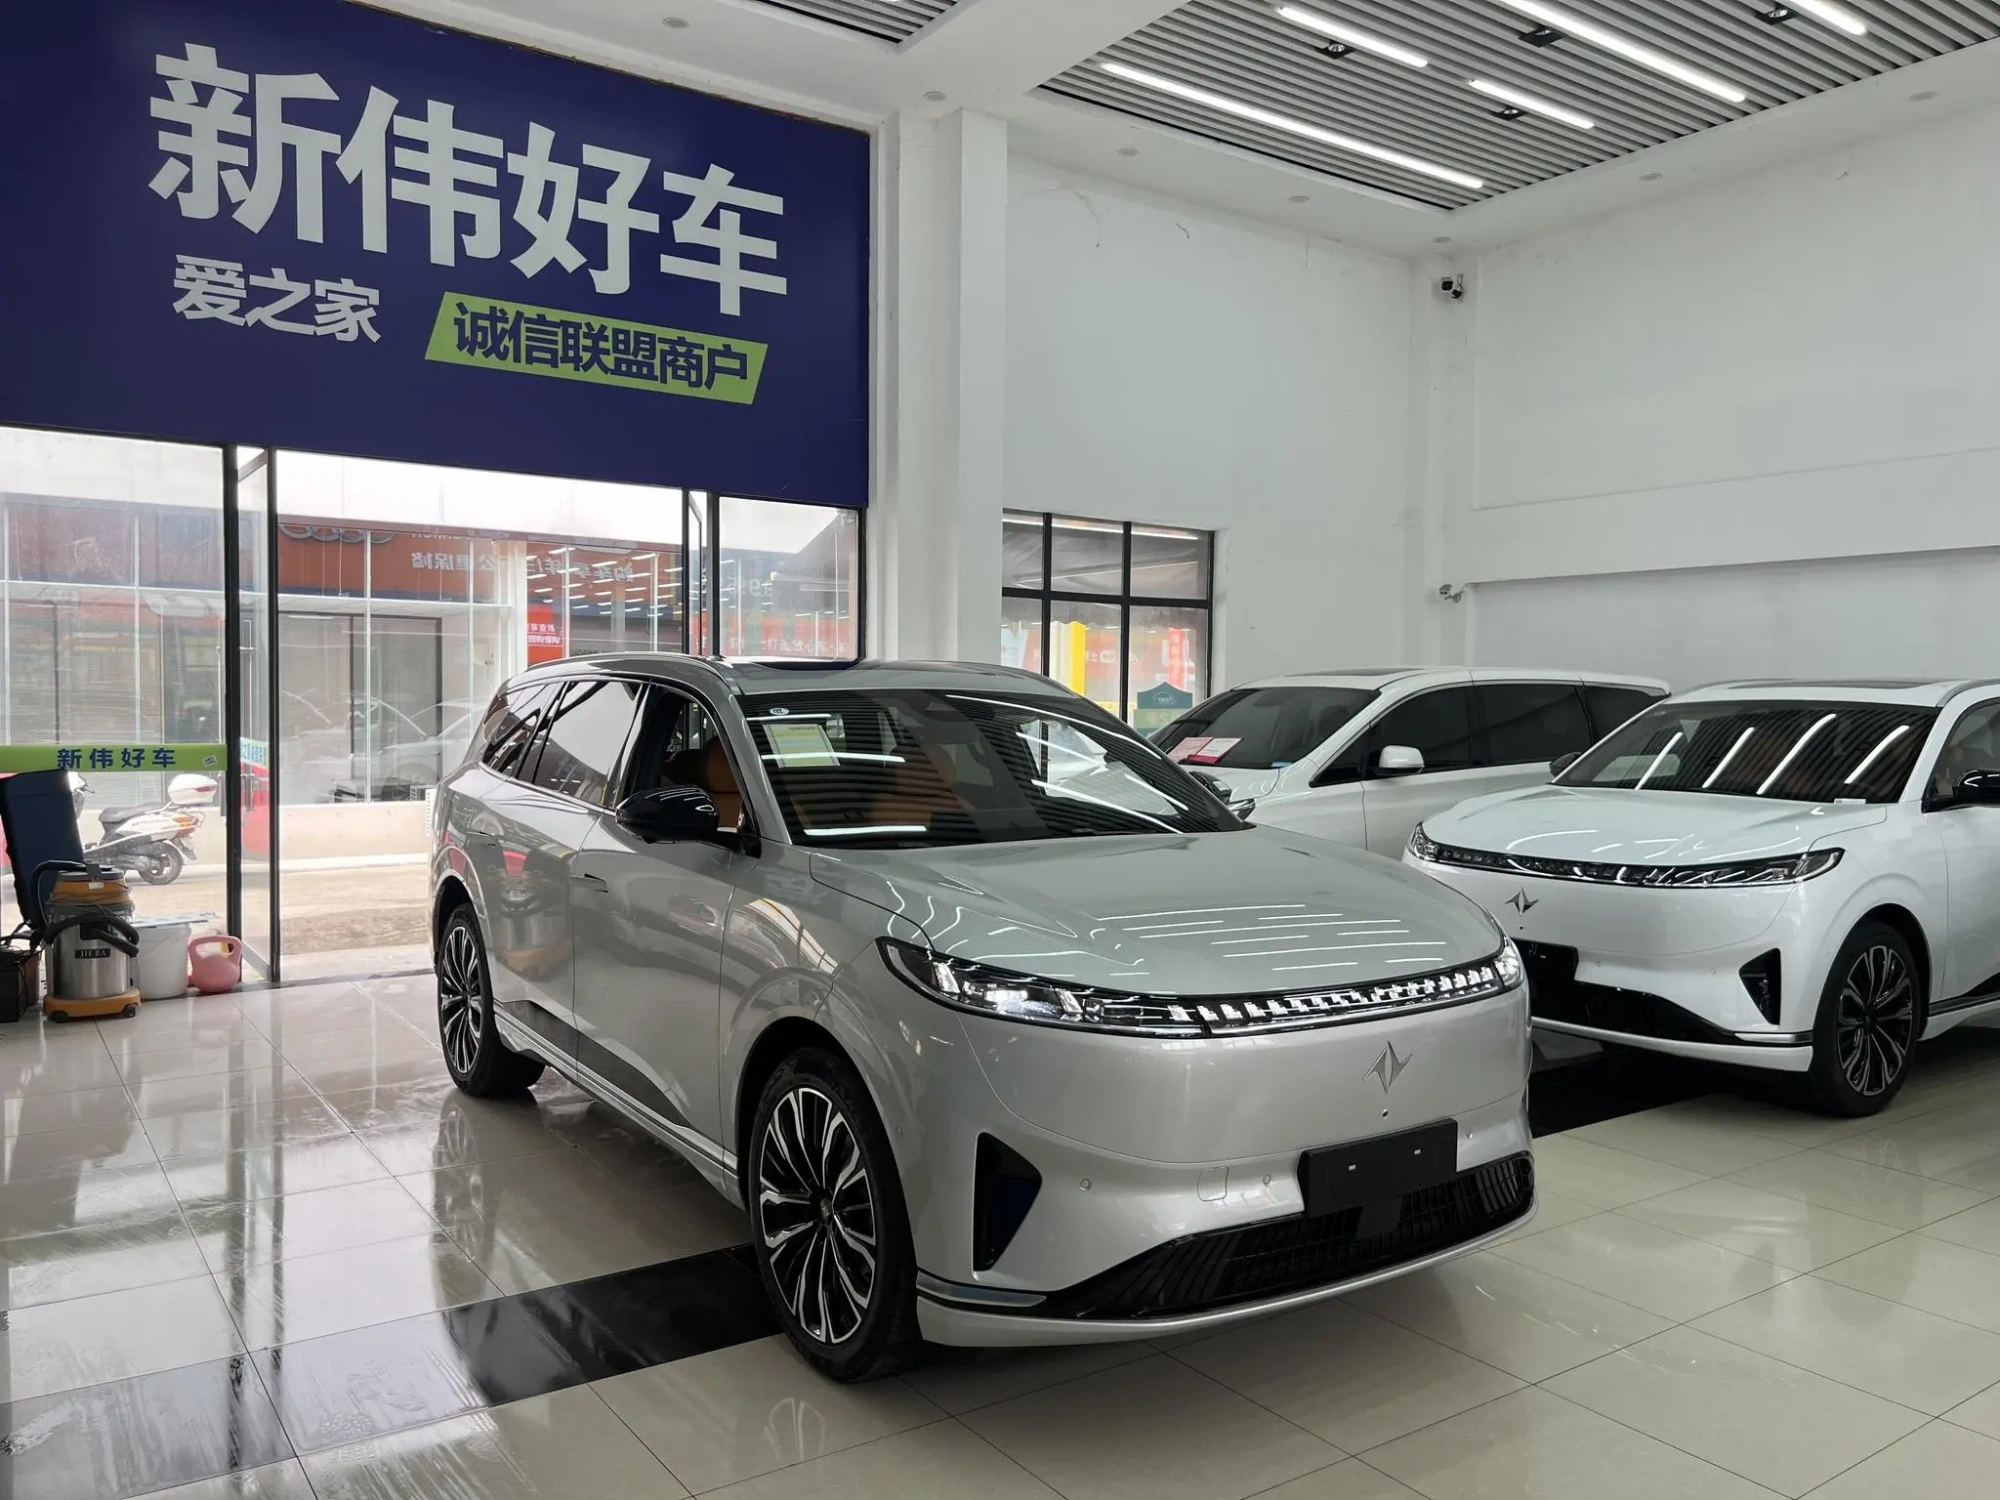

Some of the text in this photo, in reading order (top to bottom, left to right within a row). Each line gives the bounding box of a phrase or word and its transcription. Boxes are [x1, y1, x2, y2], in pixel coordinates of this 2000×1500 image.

[149, 43, 787, 316] 新伟好车
[172, 254, 381, 343] 爱之家
[453, 302, 748, 390] 诚信联盟商户
[57, 748, 176, 769] 新伟好车
